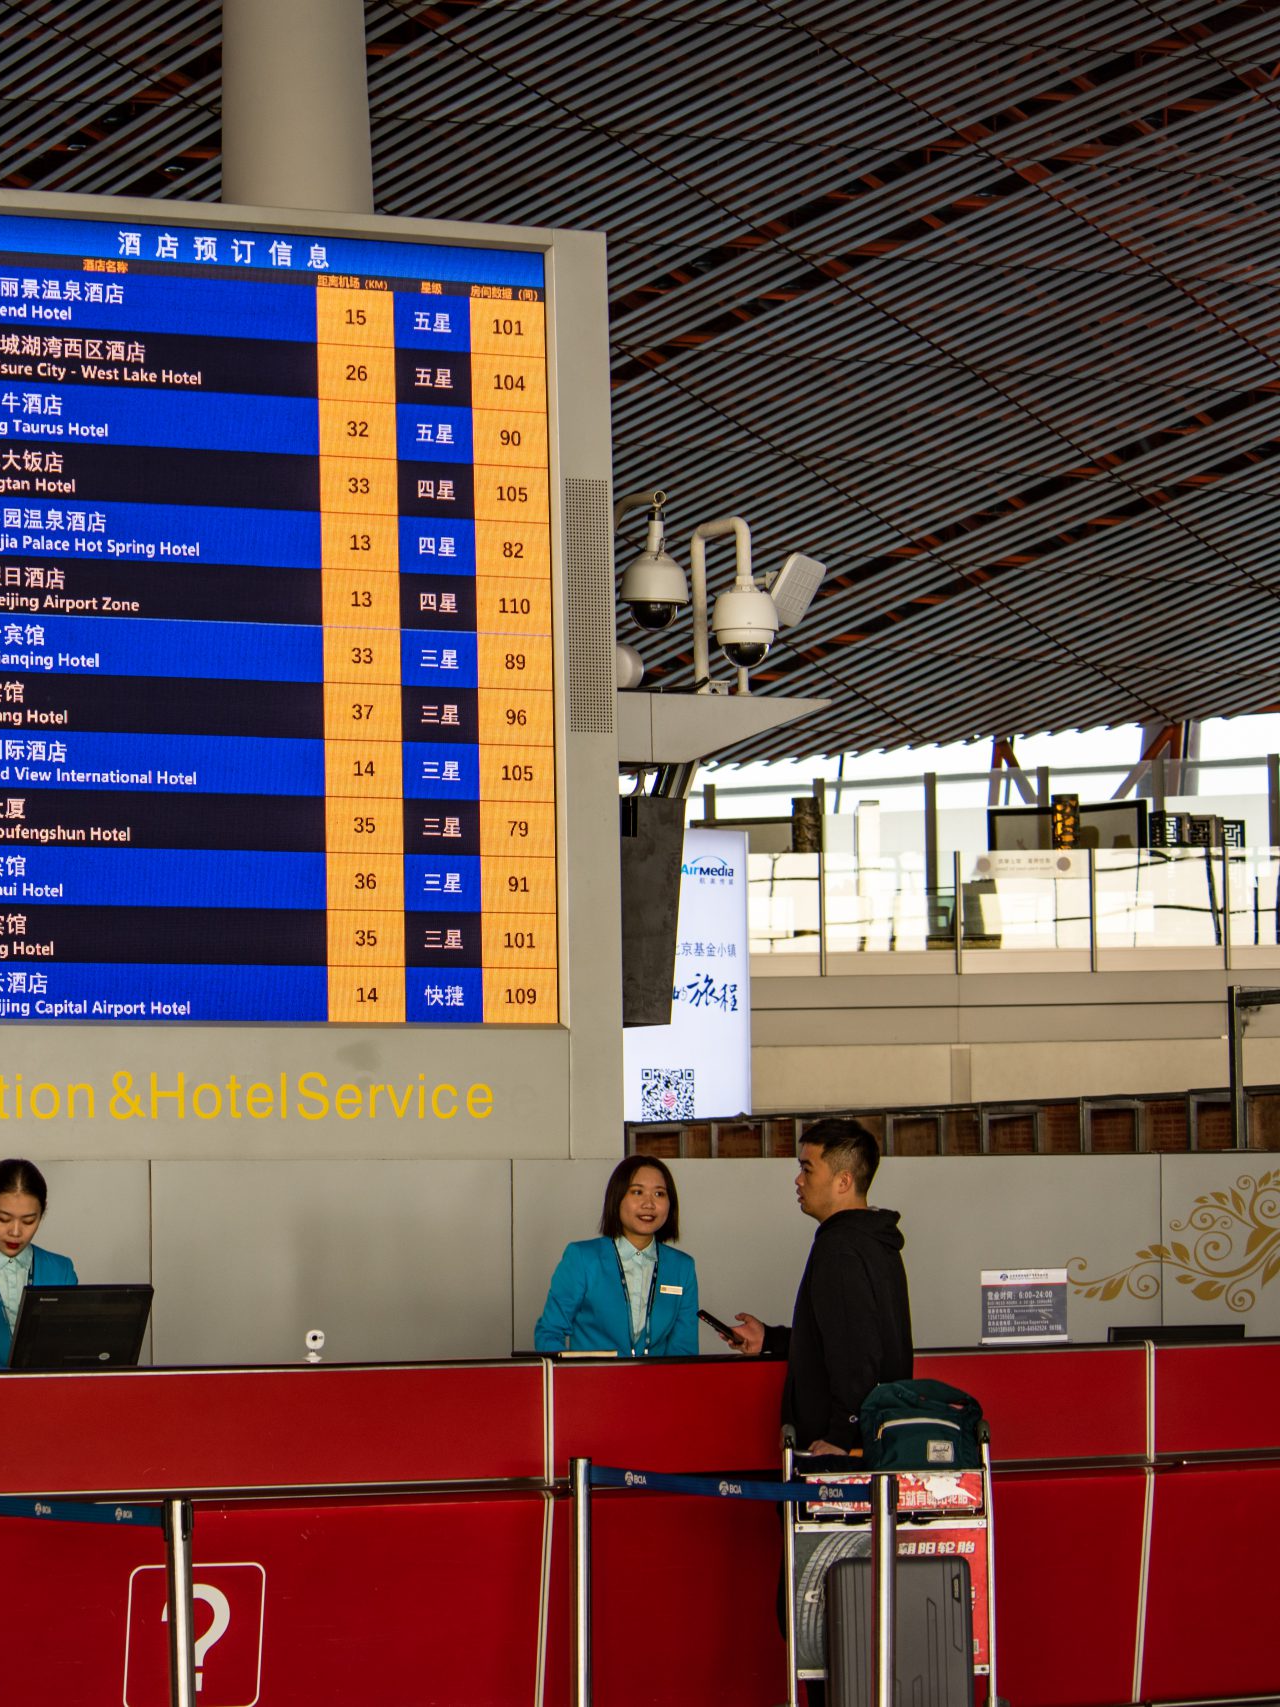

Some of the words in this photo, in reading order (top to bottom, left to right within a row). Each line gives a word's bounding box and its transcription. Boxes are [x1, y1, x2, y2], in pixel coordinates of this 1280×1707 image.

[118, 231, 329, 269] 酒店预订信息
[83, 258, 128, 274] 酒店名称
[317, 274, 359, 289] 距离机场
[421, 282, 442, 295] 星级
[32, 305, 72, 320] Hotel
[345, 309, 367, 326] 15
[413, 312, 452, 333] 五星
[493, 319, 524, 336] 101
[37, 362, 66, 381] City
[81, 365, 119, 380] West
[123, 367, 157, 383] Lake
[162, 369, 202, 385] Hotel
[23, 535, 70, 551] Palace
[75, 538, 102, 552] Hot
[107, 539, 155, 558] Spring
[160, 541, 200, 556] Hotel
[350, 534, 371, 551] 13
[419, 537, 457, 557] 四星
[503, 542, 524, 559] 82
[14, 766, 52, 781] View
[56, 768, 152, 784] International
[157, 771, 197, 785] Hotel
[353, 760, 375, 777] 14
[422, 761, 461, 781] 三星
[502, 765, 533, 781] 105
[680, 863, 734, 878] AirMedia
[13, 941, 54, 956] Hotel
[356, 987, 379, 1003] 14
[424, 985, 464, 1006] 快捷
[505, 988, 536, 1005] 109
[35, 1000, 87, 1017] Capital
[92, 1000, 146, 1018] Airport
[151, 1001, 190, 1015] Hotel
